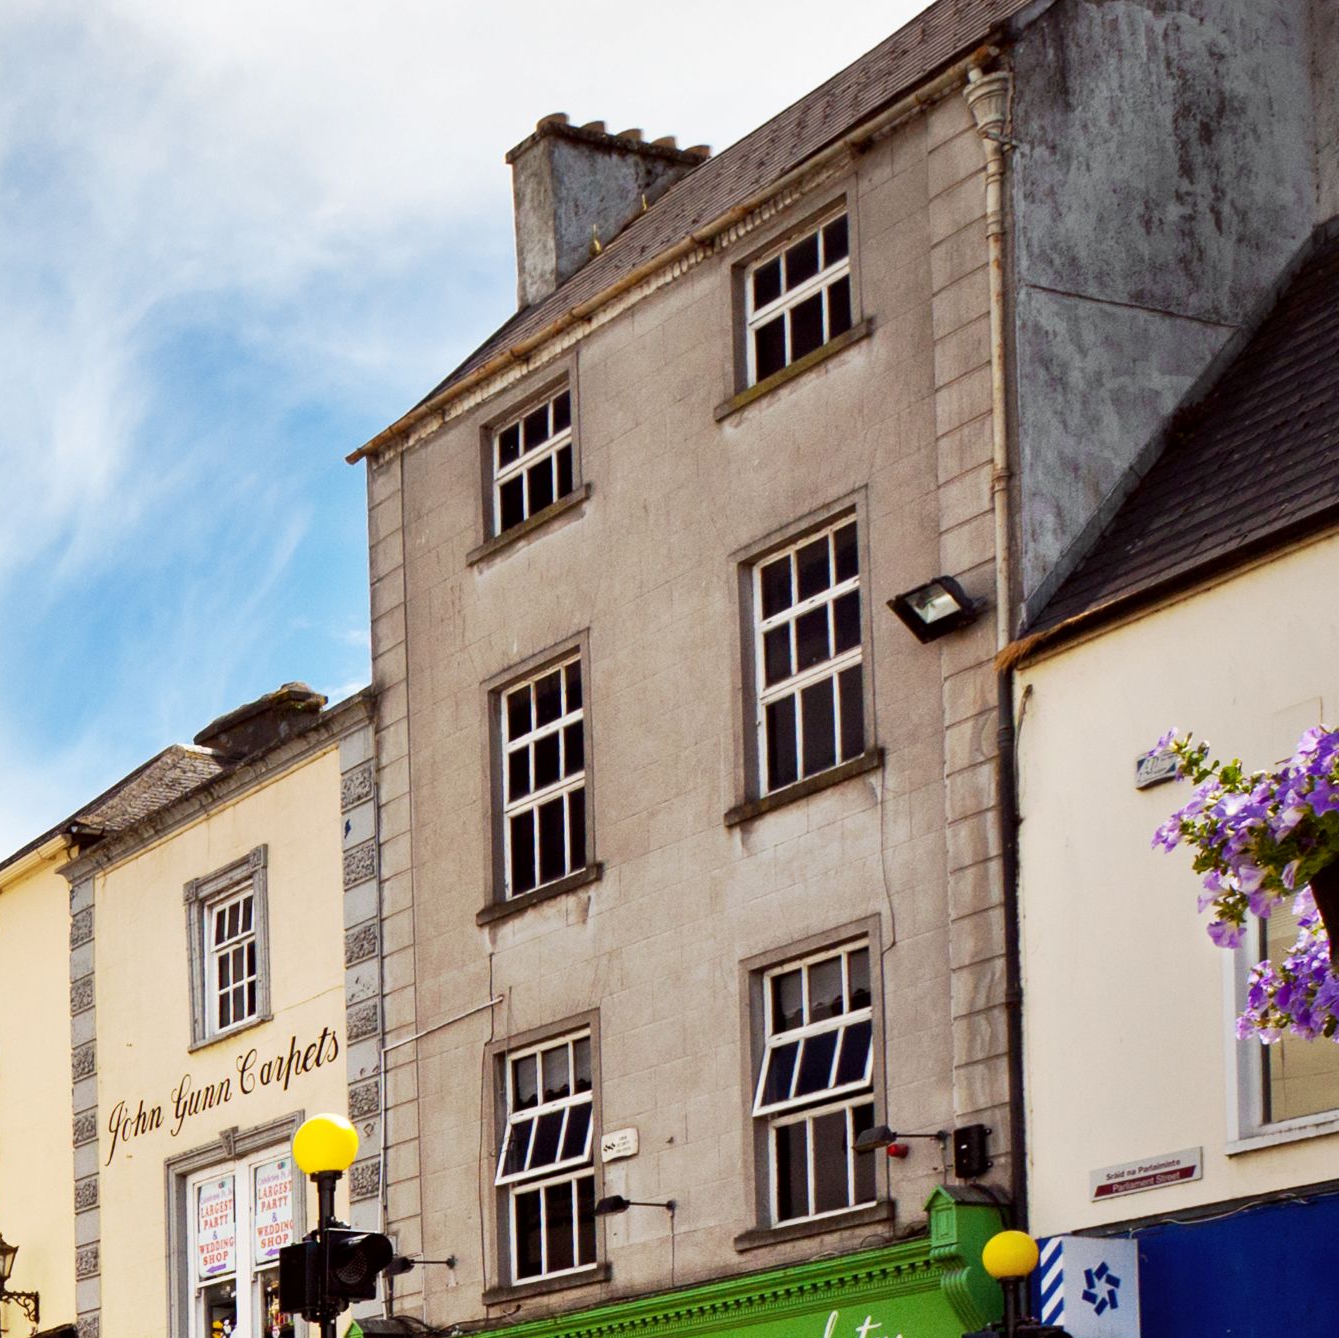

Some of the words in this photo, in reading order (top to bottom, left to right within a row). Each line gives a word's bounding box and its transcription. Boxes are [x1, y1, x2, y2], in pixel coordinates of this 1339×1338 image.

[105, 1100, 164, 1167] John
[170, 1073, 233, 1137] Gunn
[236, 1026, 339, 1095] Carpets
[258, 1180, 293, 1200] LARGEST
[1112, 1177, 1155, 1193] Parliament
[1155, 1172, 1180, 1184] Street
[201, 1199, 233, 1218] LARGEST
[261, 1196, 288, 1212] PARTY
[203, 1214, 229, 1230] PARTY
[257, 1220, 294, 1237] WEDDING
[199, 1237, 235, 1254] WEDDING
[260, 1234, 289, 1249] SHOP
[203, 1250, 229, 1266] SHOP
